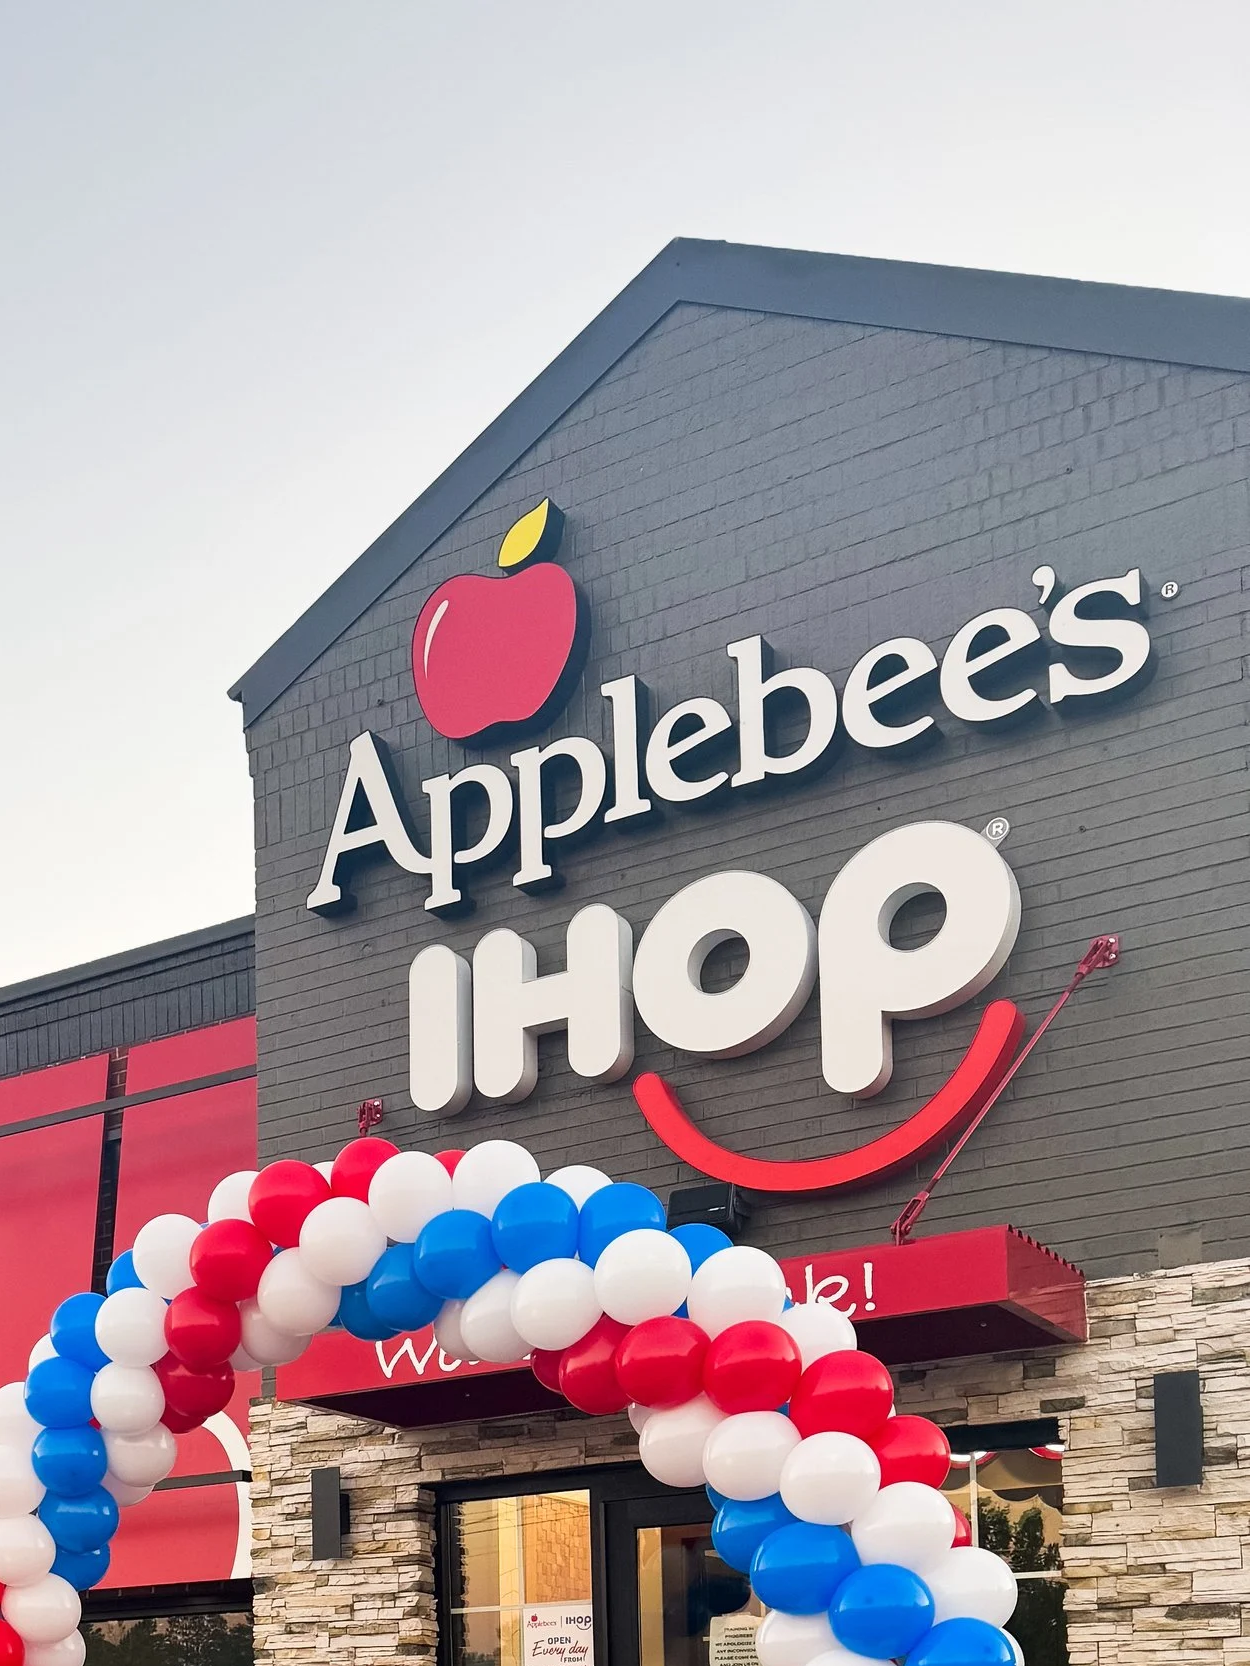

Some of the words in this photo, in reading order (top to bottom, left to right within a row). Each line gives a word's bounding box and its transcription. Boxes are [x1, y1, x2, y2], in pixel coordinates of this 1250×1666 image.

[307, 566, 1151, 915] Applebee's
[409, 821, 1022, 1116] IHOP
[565, 1615, 592, 1627] IHOP
[547, 1636, 572, 1645] OPEN
[532, 1639, 566, 1662] Every
[568, 1640, 589, 1661] day
[563, 1656, 583, 1664] FROM
